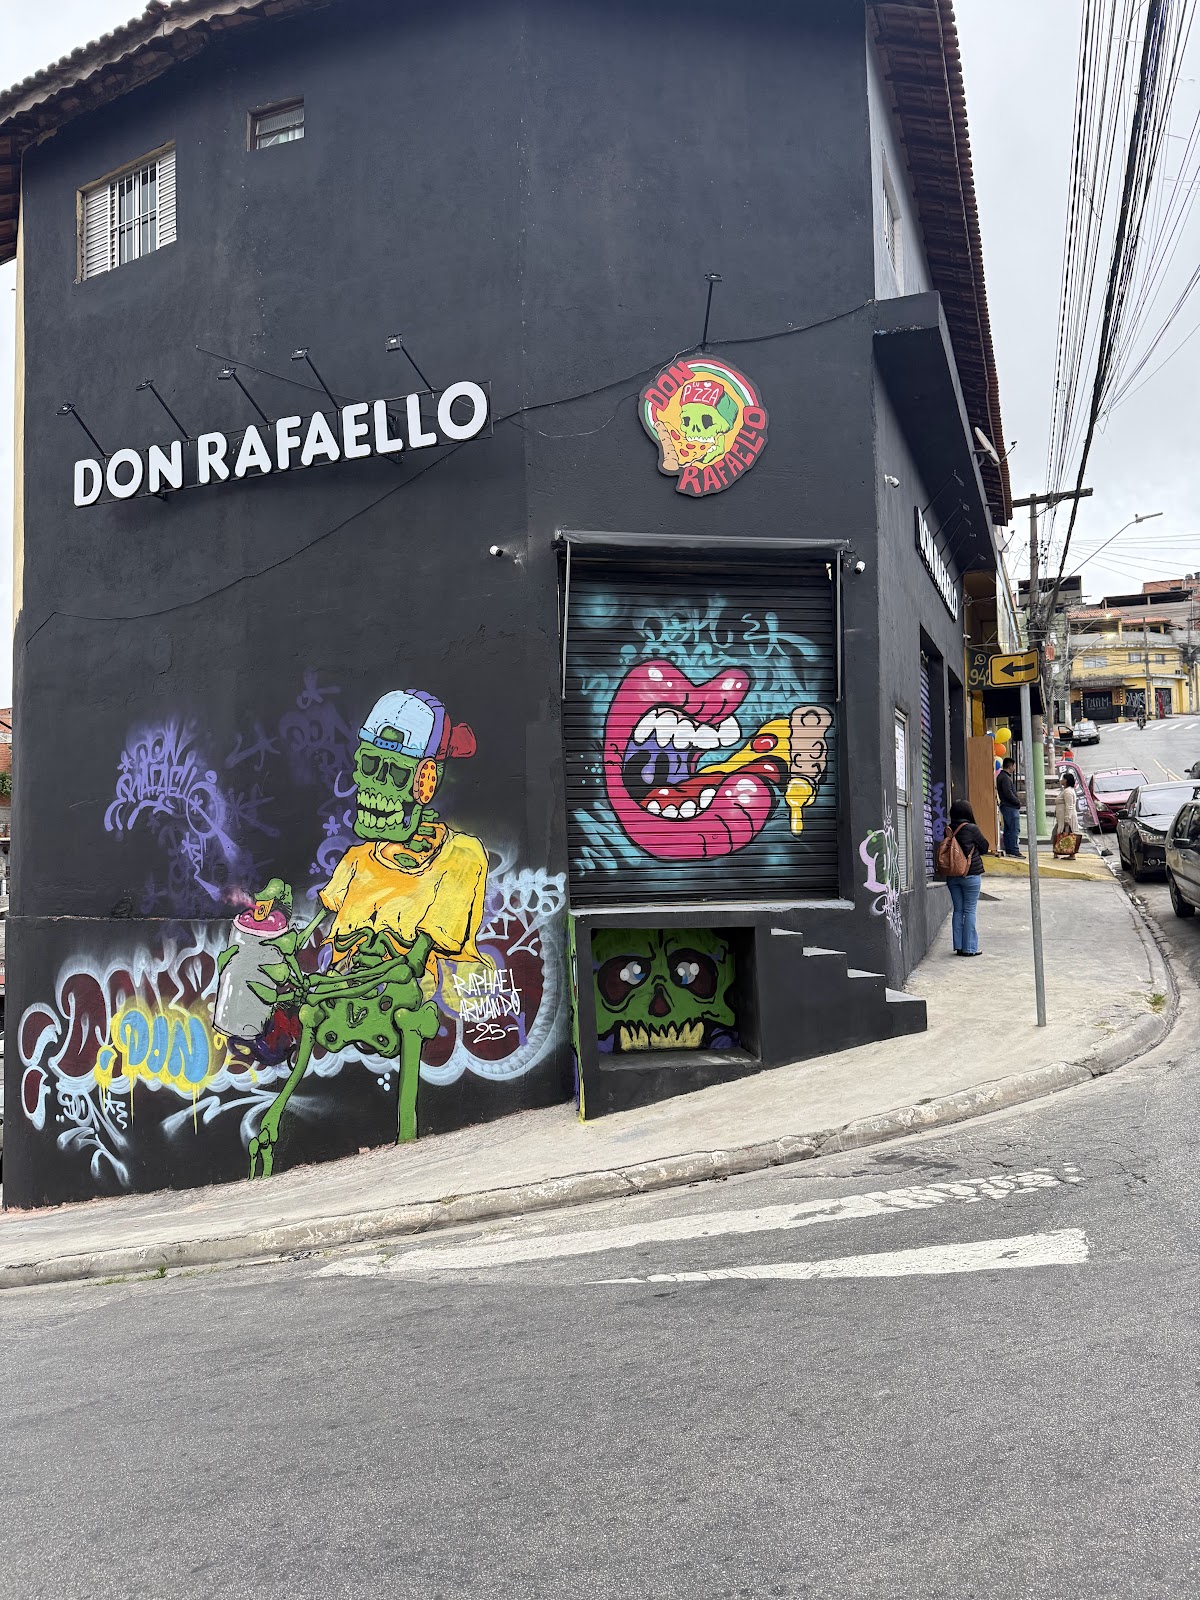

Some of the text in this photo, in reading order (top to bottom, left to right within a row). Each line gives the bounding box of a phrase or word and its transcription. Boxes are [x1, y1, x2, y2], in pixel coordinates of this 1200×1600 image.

[74, 381, 489, 506] DON RAFAELLO
[644, 361, 766, 494] DON RAFAELLO
[452, 968, 522, 996] RAPHAEL
[459, 990, 521, 1022] ARMANDO
[118, 1009, 210, 1085] DON
